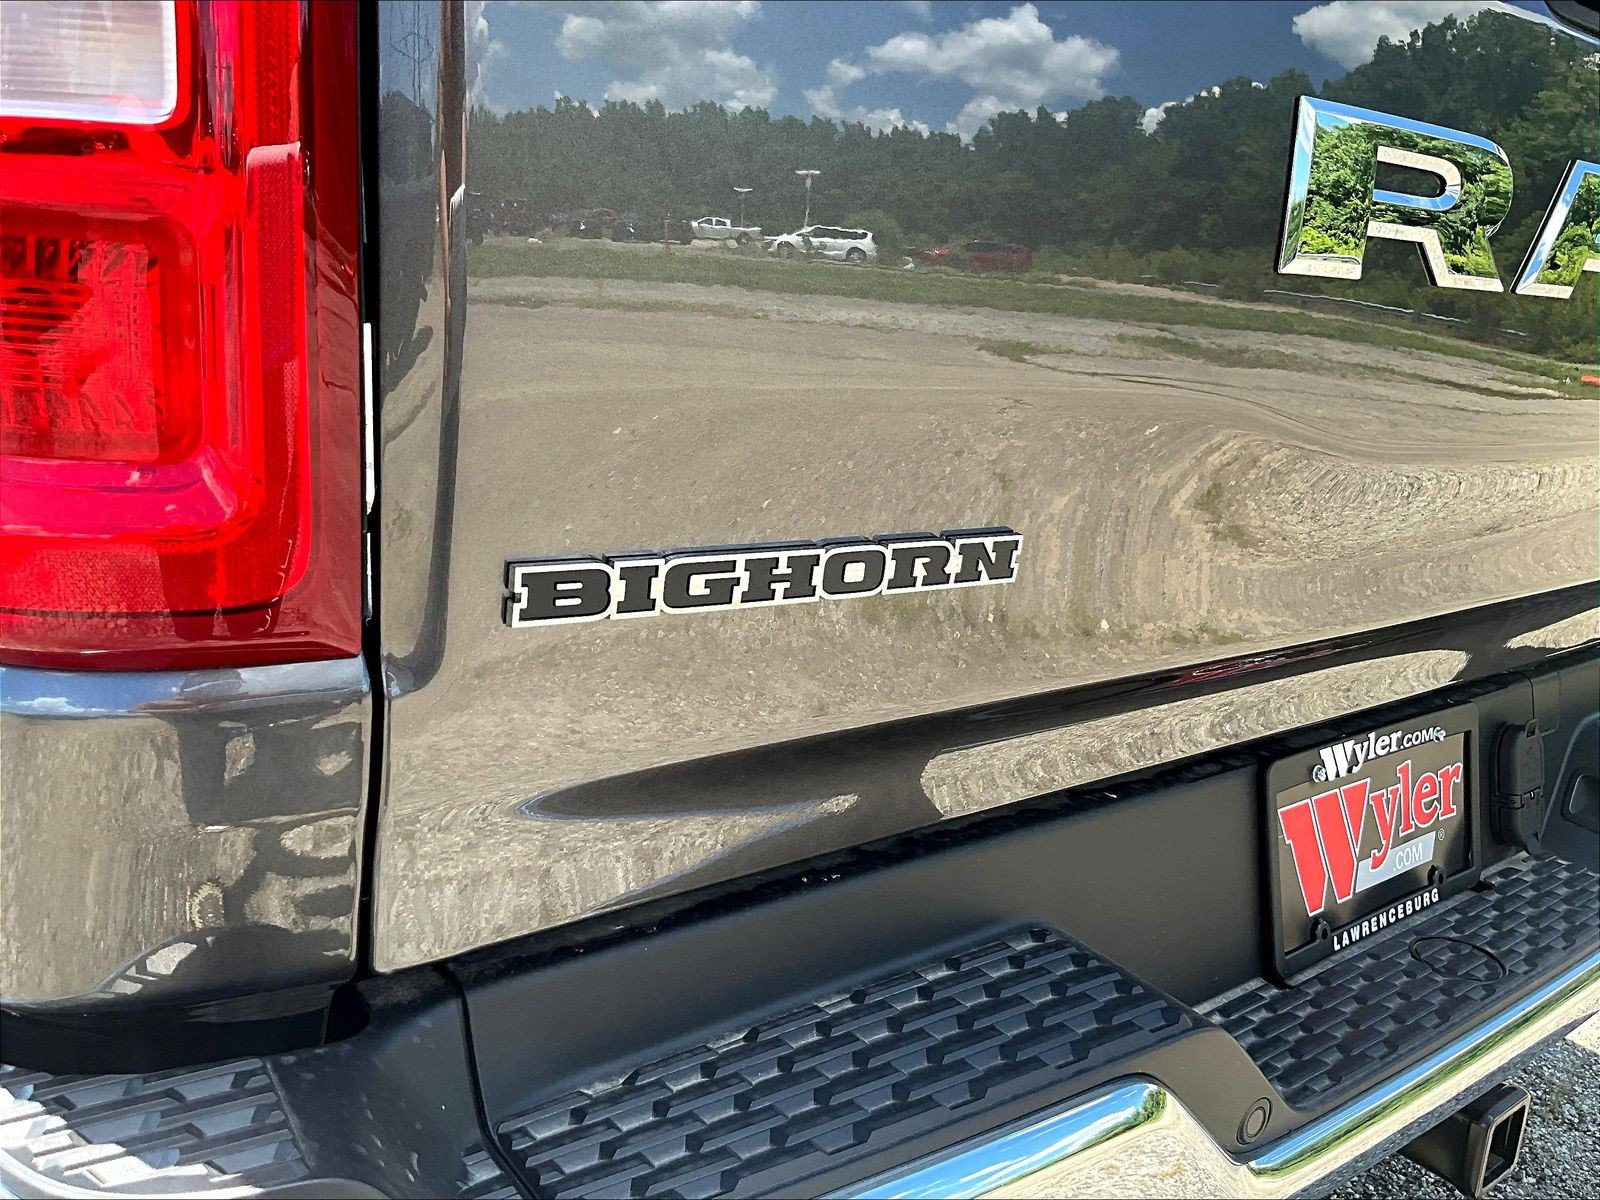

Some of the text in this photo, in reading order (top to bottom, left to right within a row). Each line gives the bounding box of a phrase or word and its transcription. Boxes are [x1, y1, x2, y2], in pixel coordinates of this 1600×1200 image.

[505, 530, 1023, 628] BIGHORN
[1278, 760, 1463, 917] Wyler
[1392, 846, 1424, 873] .COM
[1333, 887, 1440, 951] LAWRENCEBURG
